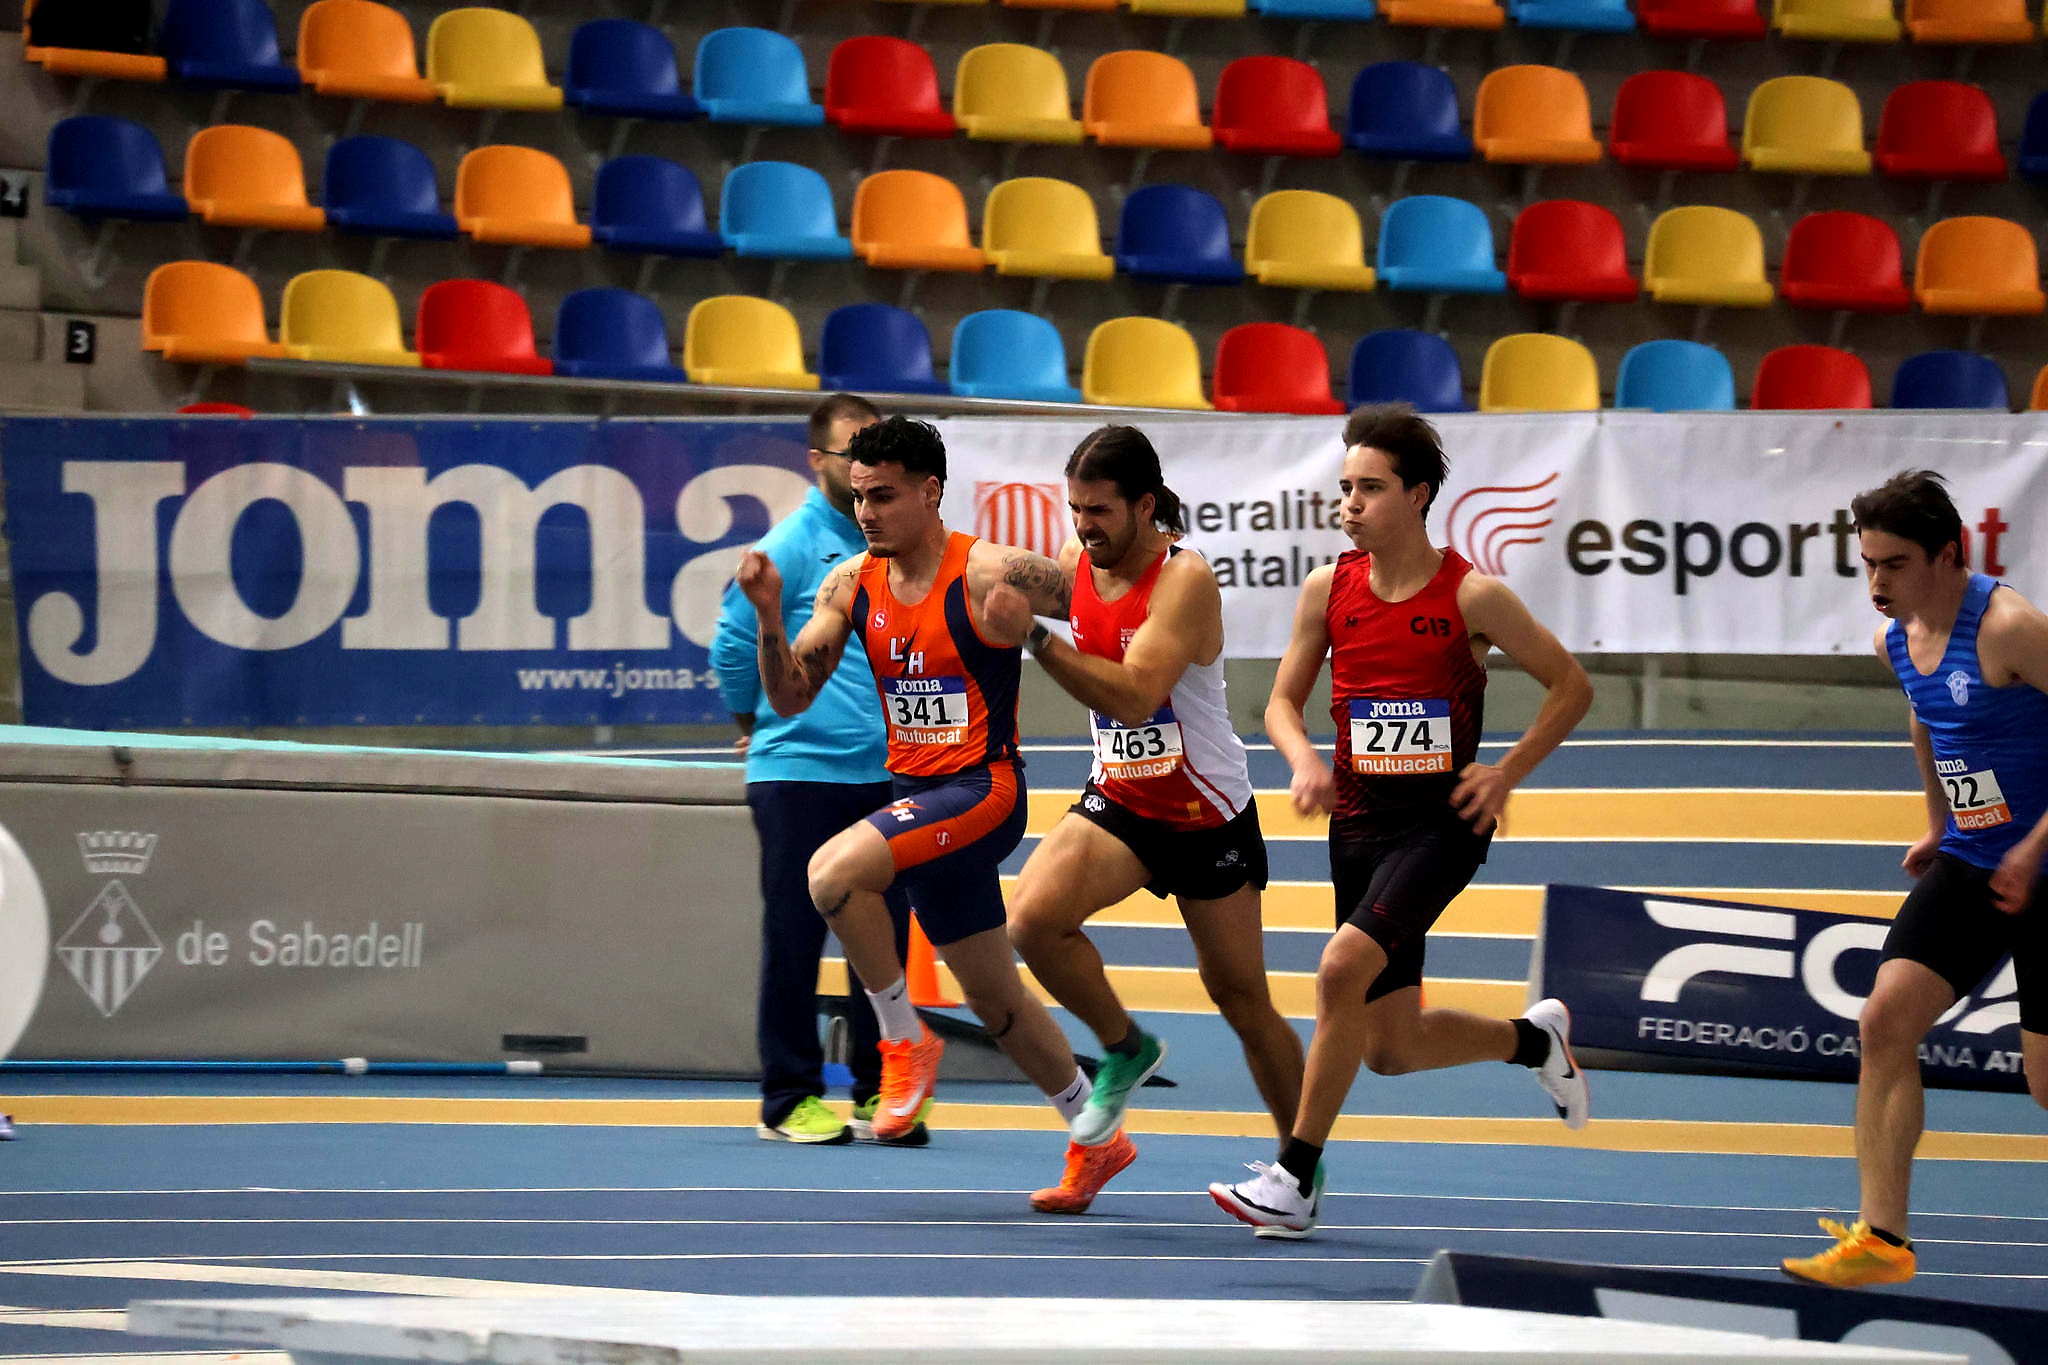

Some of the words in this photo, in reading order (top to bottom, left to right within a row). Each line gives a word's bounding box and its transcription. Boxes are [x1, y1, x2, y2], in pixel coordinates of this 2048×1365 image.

[74, 330, 89, 354] 3
[894, 696, 952, 726] 341
[896, 728, 961, 744] mutuacat
[1112, 727, 1166, 760] 463
[1365, 720, 1433, 753] 274
[1106, 758, 1177, 779] mutuacat
[1358, 755, 1445, 773] mutuacat
[1947, 776, 1985, 808] 22
[176, 921, 229, 966] de
[248, 919, 424, 968] Sabadell
[1638, 1015, 1810, 1054] FEDERACIÓ
